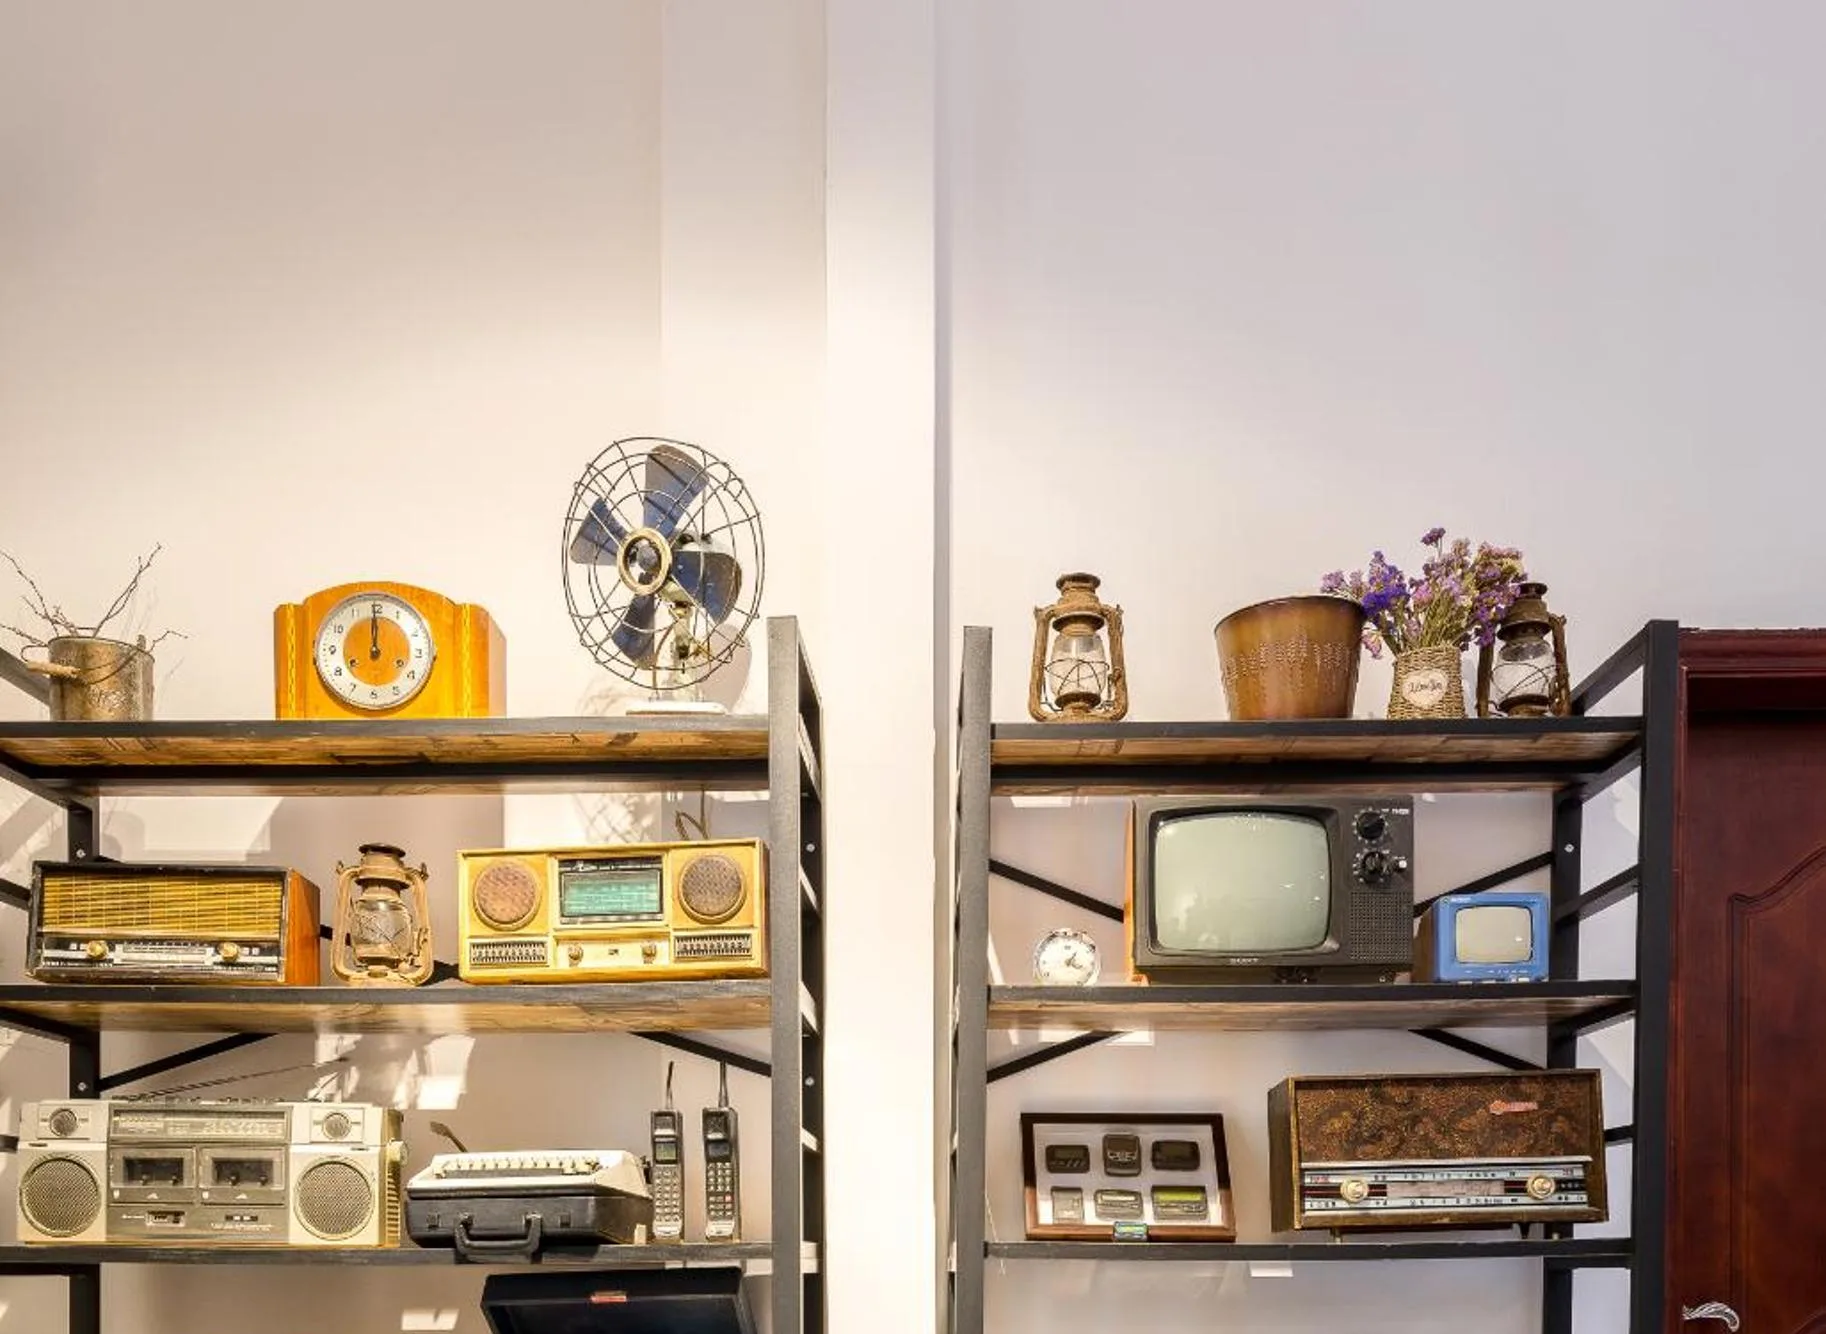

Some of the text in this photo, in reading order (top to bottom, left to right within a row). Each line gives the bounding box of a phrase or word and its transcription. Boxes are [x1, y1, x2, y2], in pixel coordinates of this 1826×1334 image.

[333, 624, 344, 634] 10
[329, 645, 337, 655] 9
[334, 667, 342, 677] 8
[407, 670, 415, 680] 4
[370, 689, 378, 700] 6
[392, 686, 400, 696] 5
